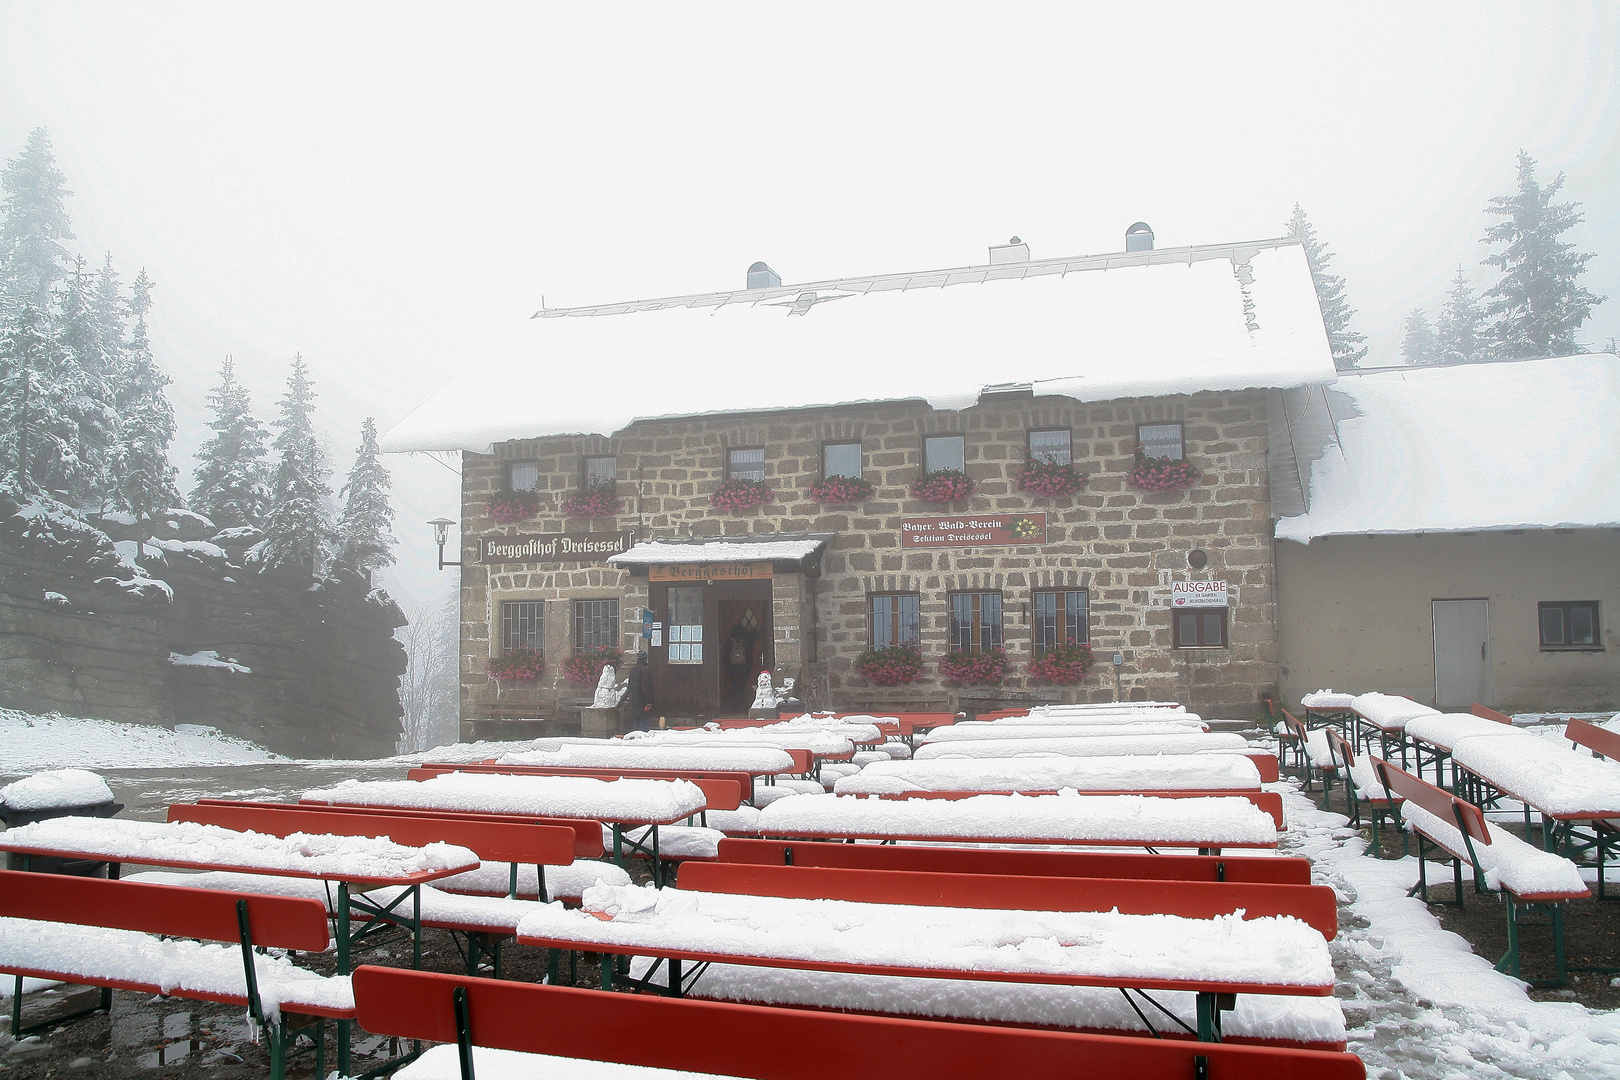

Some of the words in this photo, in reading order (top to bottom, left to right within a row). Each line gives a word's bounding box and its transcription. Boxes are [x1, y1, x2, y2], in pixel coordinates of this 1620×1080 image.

[938, 520, 1002, 530] Wald-Verein
[912, 534, 945, 543] Sektion
[947, 533, 992, 542] Dreisessel
[561, 535, 624, 553] Dreisessel
[669, 565, 754, 579] Berggasthof
[1173, 582, 1226, 592] AUSGABE
